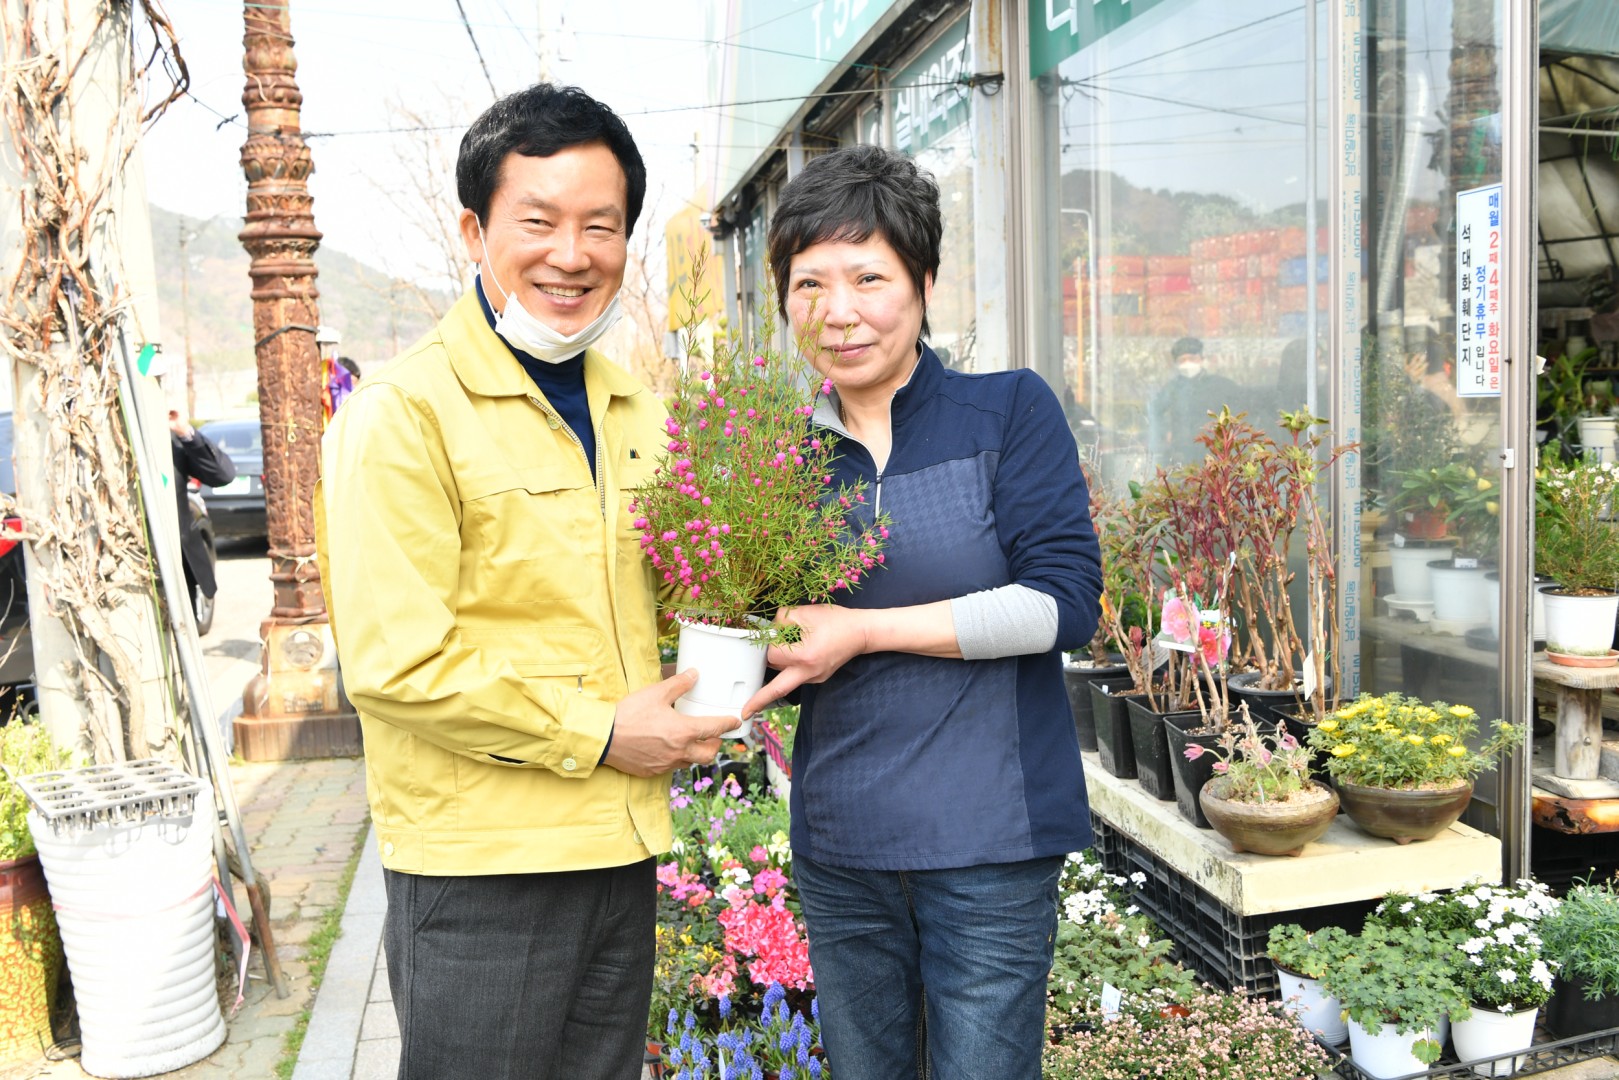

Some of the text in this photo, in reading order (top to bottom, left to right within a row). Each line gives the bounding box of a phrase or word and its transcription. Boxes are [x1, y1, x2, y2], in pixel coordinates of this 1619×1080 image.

[894, 33, 976, 151] 실내외조
[1488, 192, 1500, 227] 매월
[1475, 345, 1486, 387] 입니다
